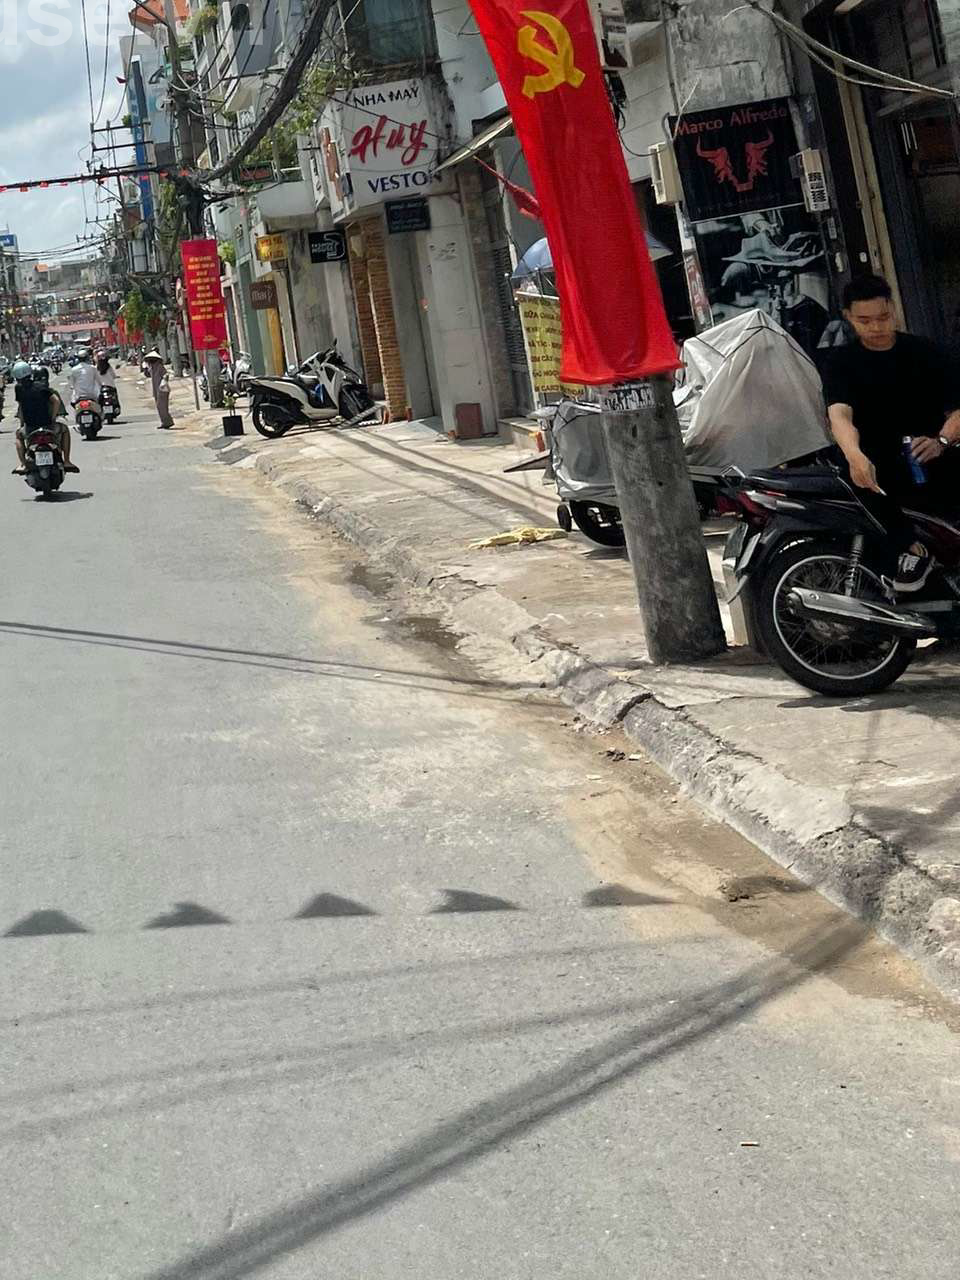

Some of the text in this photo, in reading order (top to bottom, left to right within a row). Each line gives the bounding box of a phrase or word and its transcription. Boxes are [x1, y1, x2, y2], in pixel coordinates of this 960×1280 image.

[673, 105, 788, 136] Marco Alfredo
[348, 114, 428, 166] Huy
[367, 170, 433, 193] VESTO
